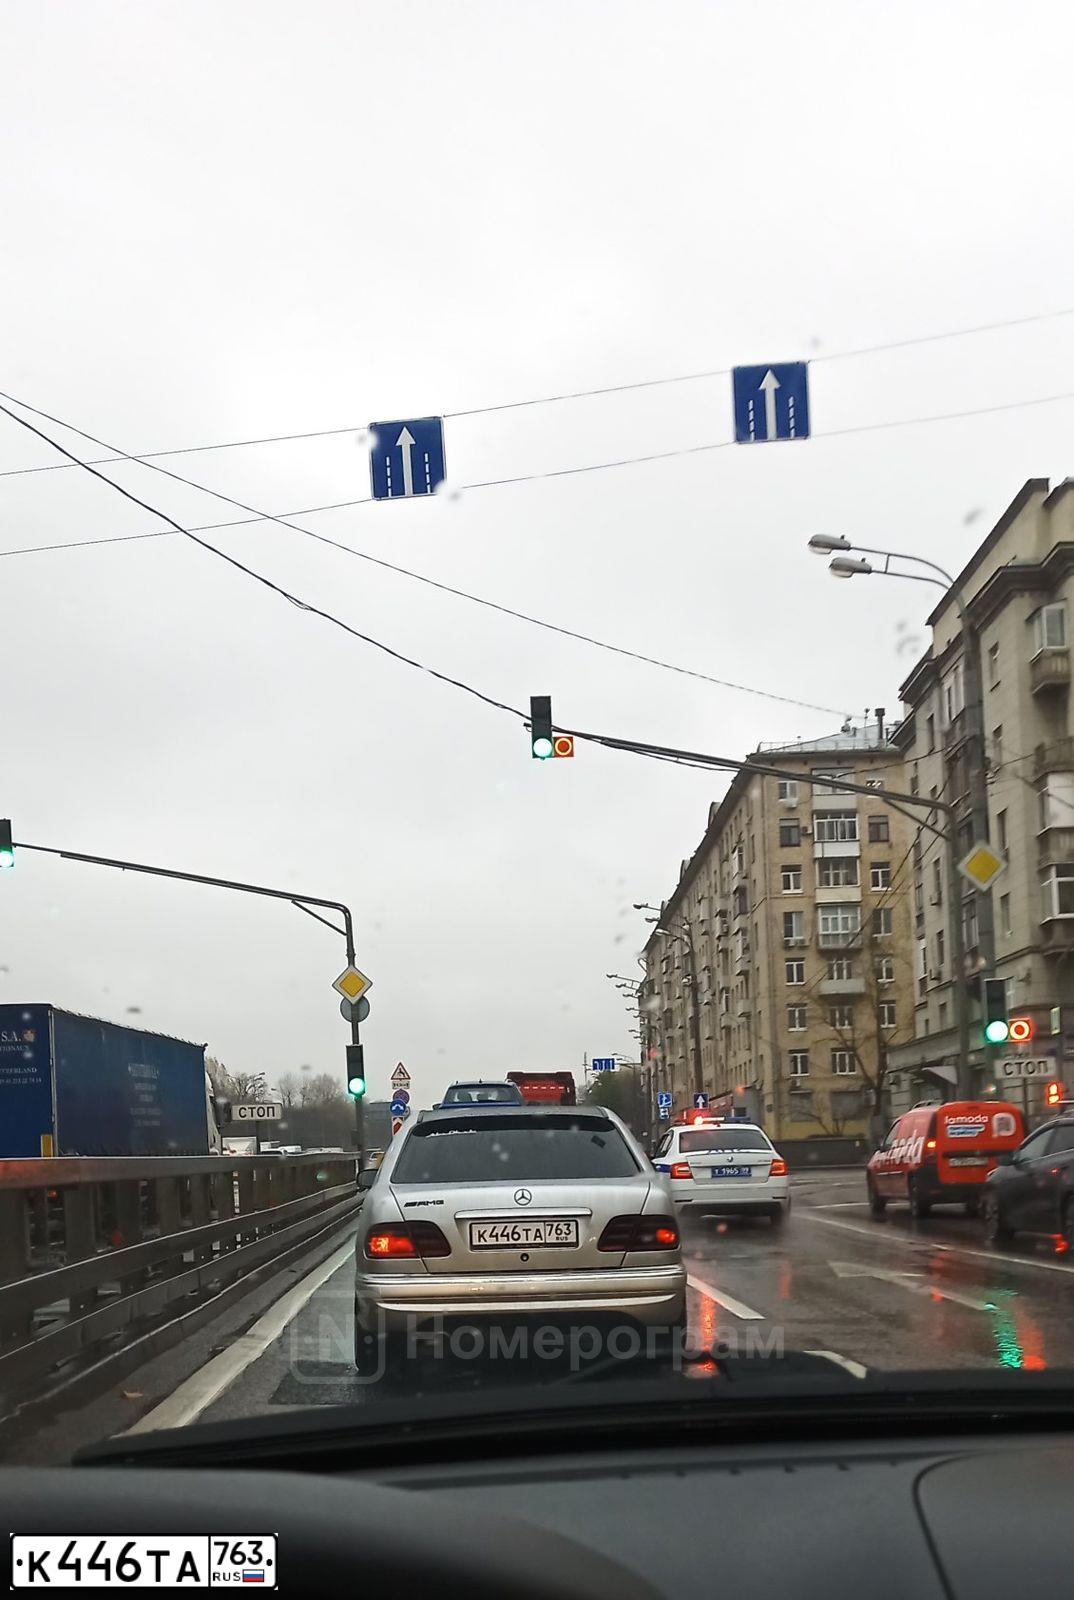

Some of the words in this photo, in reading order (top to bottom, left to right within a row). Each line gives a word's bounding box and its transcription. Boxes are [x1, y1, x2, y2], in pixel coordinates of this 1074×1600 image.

[1003, 1060, 1048, 1076] СТОП
[238, 1106, 275, 1118] СТОП
[944, 1115, 989, 1124] lamoda
[477, 1224, 543, 1242] К446ТА
[546, 1223, 572, 1236] 763
